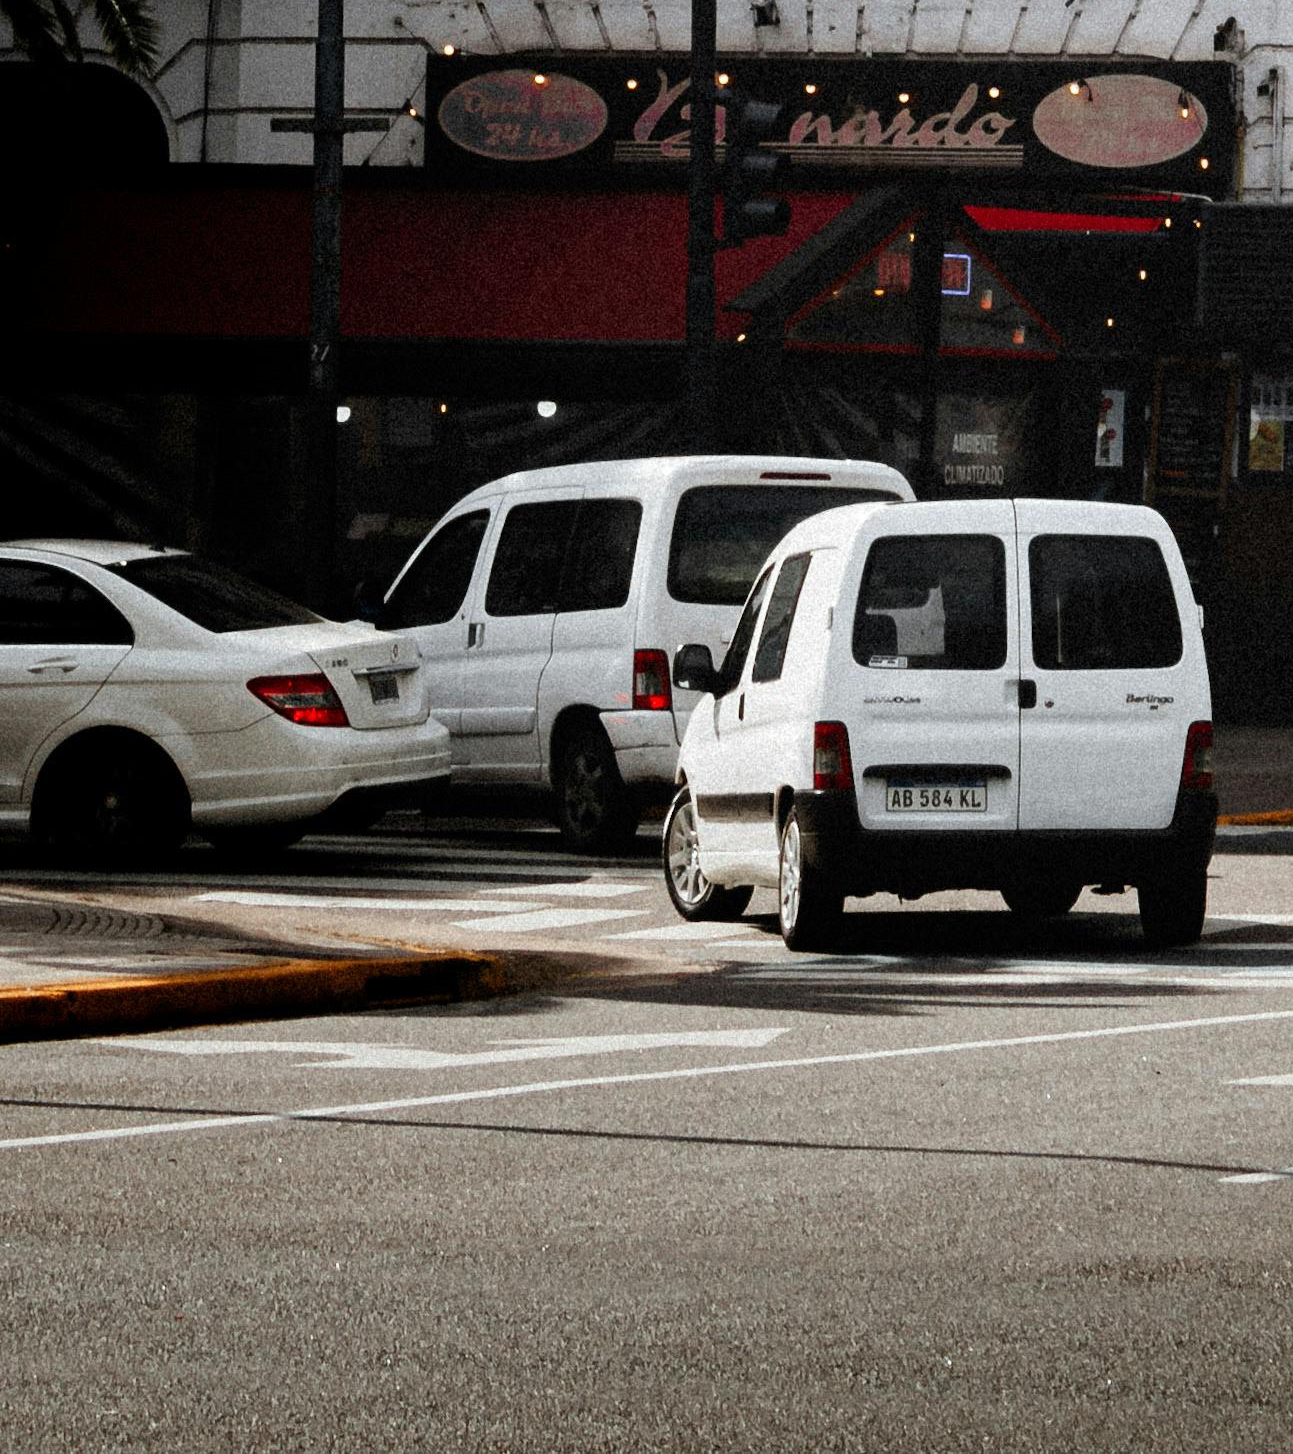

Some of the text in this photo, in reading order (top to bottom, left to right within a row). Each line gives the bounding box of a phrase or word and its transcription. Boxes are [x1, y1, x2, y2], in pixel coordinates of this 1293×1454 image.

[952, 434, 999, 454] AMBIENTE
[944, 465, 1005, 485] CLIMATIZADO
[892, 789, 982, 808] AB 584 KL
